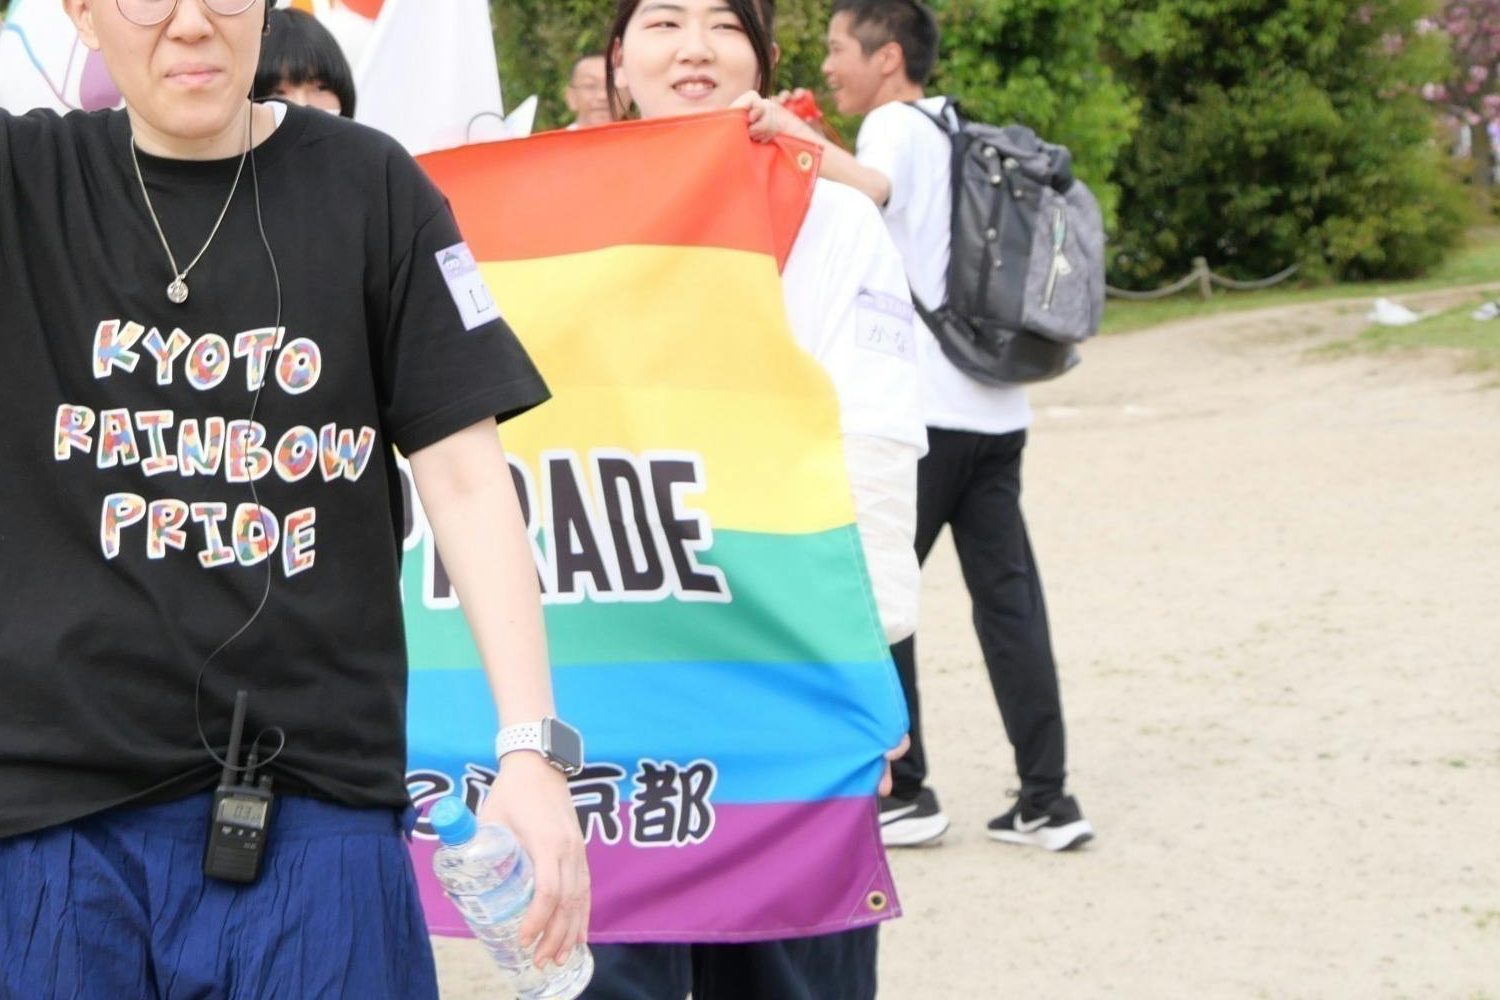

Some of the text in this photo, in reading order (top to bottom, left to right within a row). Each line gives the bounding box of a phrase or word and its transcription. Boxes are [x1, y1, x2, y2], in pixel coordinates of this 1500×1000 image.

[92, 318, 322, 395] KYOTO
[54, 403, 376, 483] RAINBOW
[100, 492, 317, 578] PRIDE
